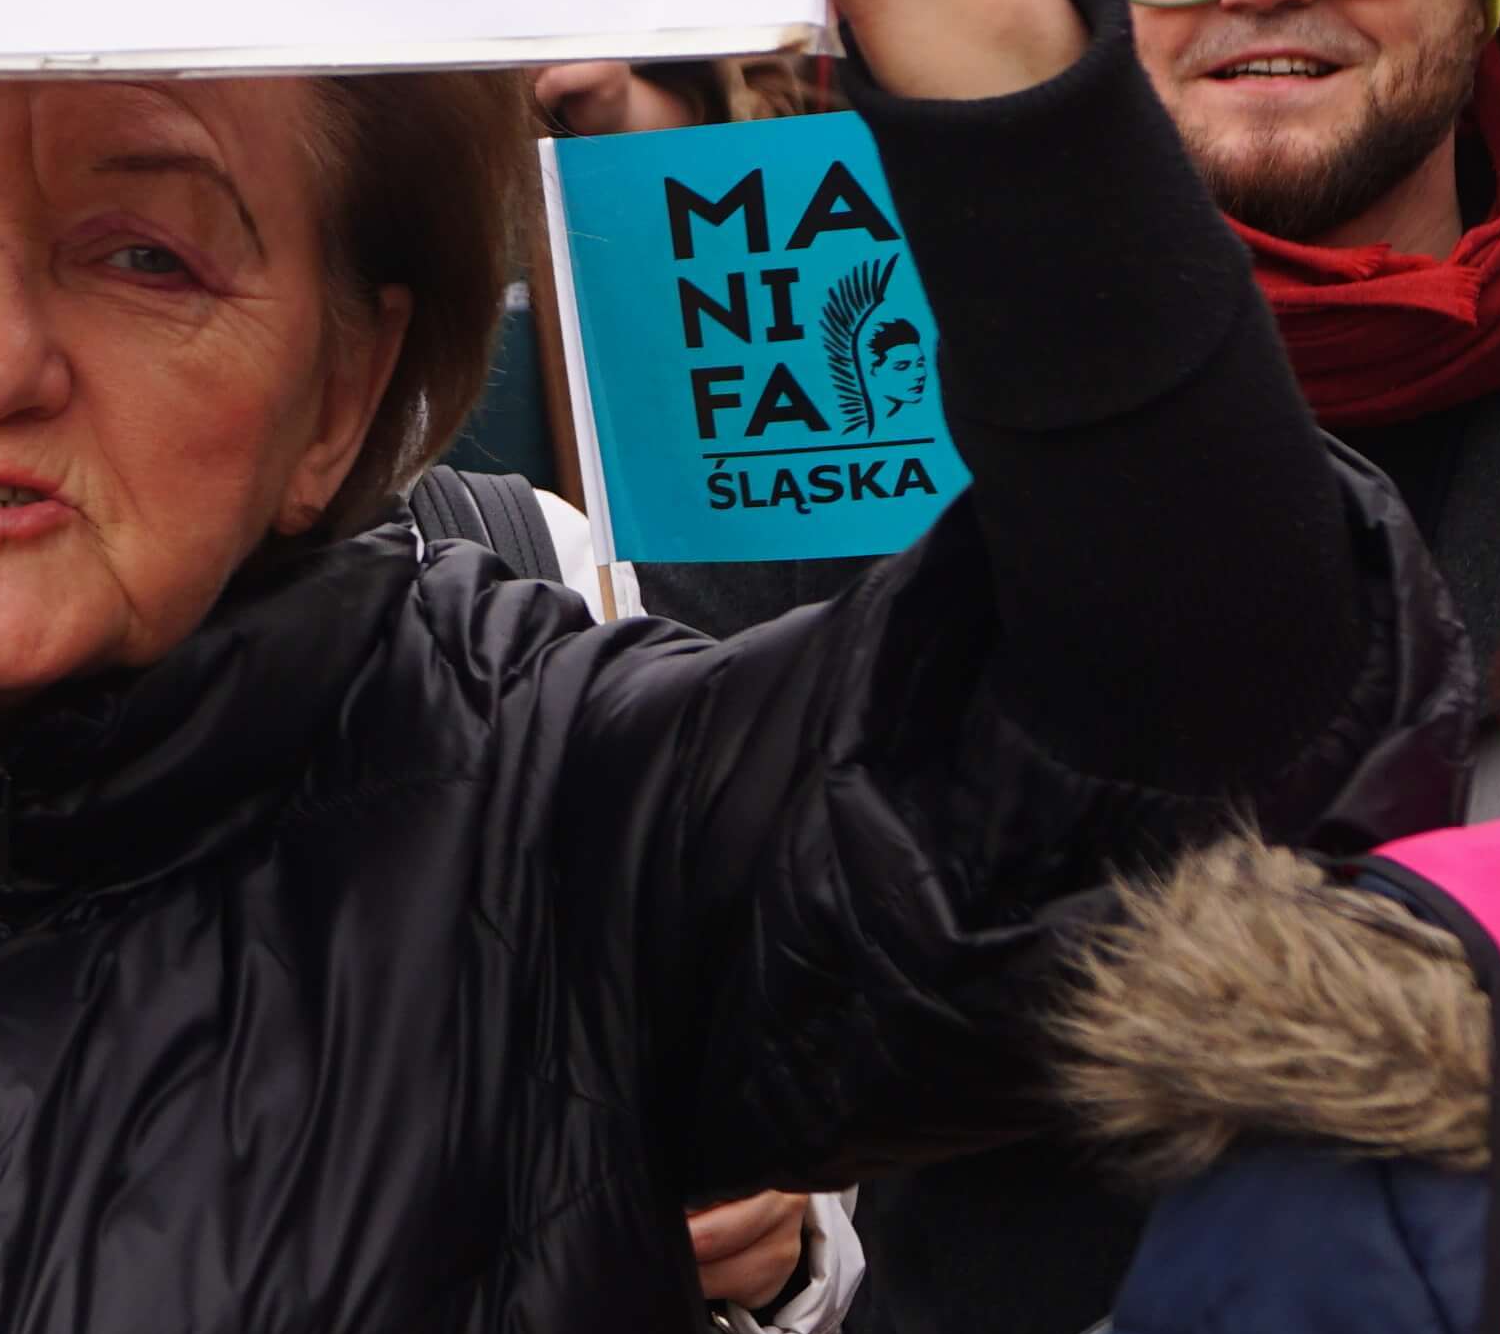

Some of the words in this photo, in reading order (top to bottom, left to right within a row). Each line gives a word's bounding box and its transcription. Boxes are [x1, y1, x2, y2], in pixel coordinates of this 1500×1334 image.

[664, 160, 902, 260] MA
[677, 267, 804, 348] NI
[690, 362, 831, 440] FA
[708, 458, 938, 515] ŚLĄSKA
